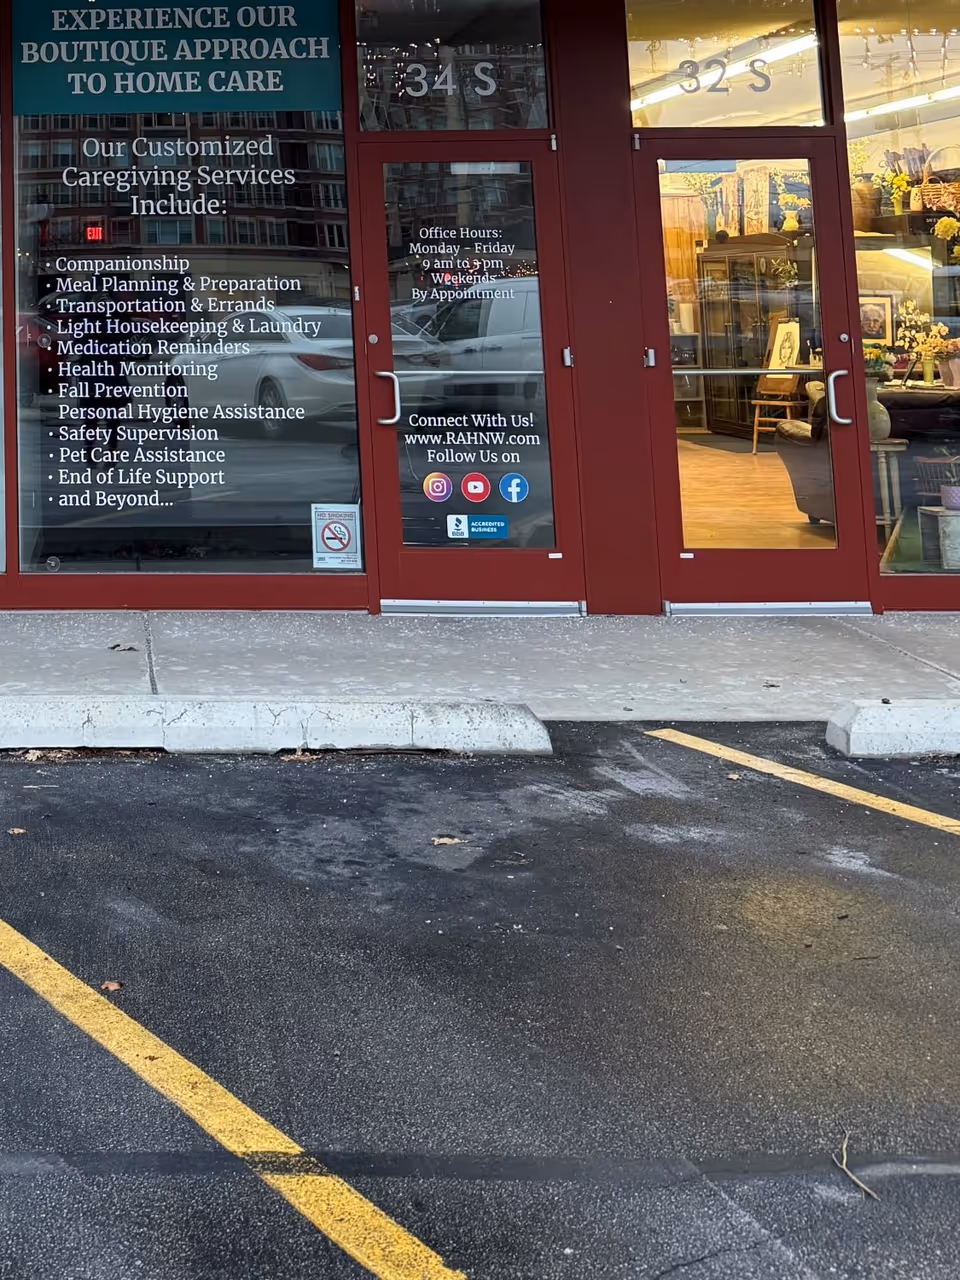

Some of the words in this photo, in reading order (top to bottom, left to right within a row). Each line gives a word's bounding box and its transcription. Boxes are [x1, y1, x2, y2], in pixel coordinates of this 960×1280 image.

[52, 7, 230, 30] EXPERIENCE
[237, 6, 297, 27] OUR
[21, 40, 167, 66] BOUTIQUE
[173, 37, 329, 60] APPROACH
[68, 73, 106, 94] TO
[114, 72, 201, 93] HOME
[209, 70, 283, 92] CARE
[406, 64, 456, 97] 34
[474, 61, 497, 96] S
[679, 59, 729, 93] 32
[749, 59, 771, 92] S
[83, 138, 126, 157] Our
[132, 135, 273, 156] Customized
[63, 166, 191, 192] Caregiving
[198, 164, 295, 185] Services
[131, 193, 226, 214] Include:
[88, 228, 102, 239] EXIT
[420, 227, 456, 238] Office
[460, 228, 502, 238] Hours:
[410, 242, 460, 256] Monday
[475, 242, 514, 256] Friday
[56, 255, 189, 275] Companionship
[422, 259, 431, 271] 9
[433, 259, 454, 269] am
[456, 258, 470, 269] to
[482, 258, 504, 272] pm
[56, 277, 97, 292] Meal
[102, 276, 178, 295] Planning
[183, 277, 195, 291] &
[200, 277, 301, 295] Preparation
[431, 272, 497, 284] Weekends
[411, 289, 428, 300] By
[430, 288, 515, 301] Appointment
[56, 299, 185, 316] Transportation
[191, 298, 203, 312] &
[208, 296, 274, 315] Errands
[57, 318, 101, 338] Light
[106, 318, 227, 337] Housekeeping
[233, 319, 244, 333] &
[249, 317, 321, 337] Laundry
[57, 339, 153, 355] Medication
[157, 339, 250, 354] Reminders
[58, 361, 115, 376] Health
[119, 362, 218, 380] Monitoring
[59, 382, 89, 397] Fall
[95, 382, 188, 397] Prevention
[59, 403, 133, 419] Personal
[138, 404, 208, 423] Hygiene
[212, 404, 304, 419] Assistance
[409, 414, 468, 426] Connect
[471, 414, 507, 427] With
[511, 413, 533, 427] Us!
[59, 425, 112, 445] Safety
[117, 426, 218, 445] Supervision
[405, 432, 540, 444] www.RAHNW.com
[60, 448, 87, 462] Pet
[91, 448, 129, 462] Care
[134, 447, 225, 462] Assistance
[427, 449, 476, 462] Follow
[480, 450, 498, 462] Us
[502, 453, 520, 462] on
[59, 468, 91, 484] End
[97, 468, 114, 484] of
[118, 468, 151, 484] Life
[156, 469, 225, 488] Support
[59, 490, 90, 506] and
[96, 490, 173, 510] Beyond...
